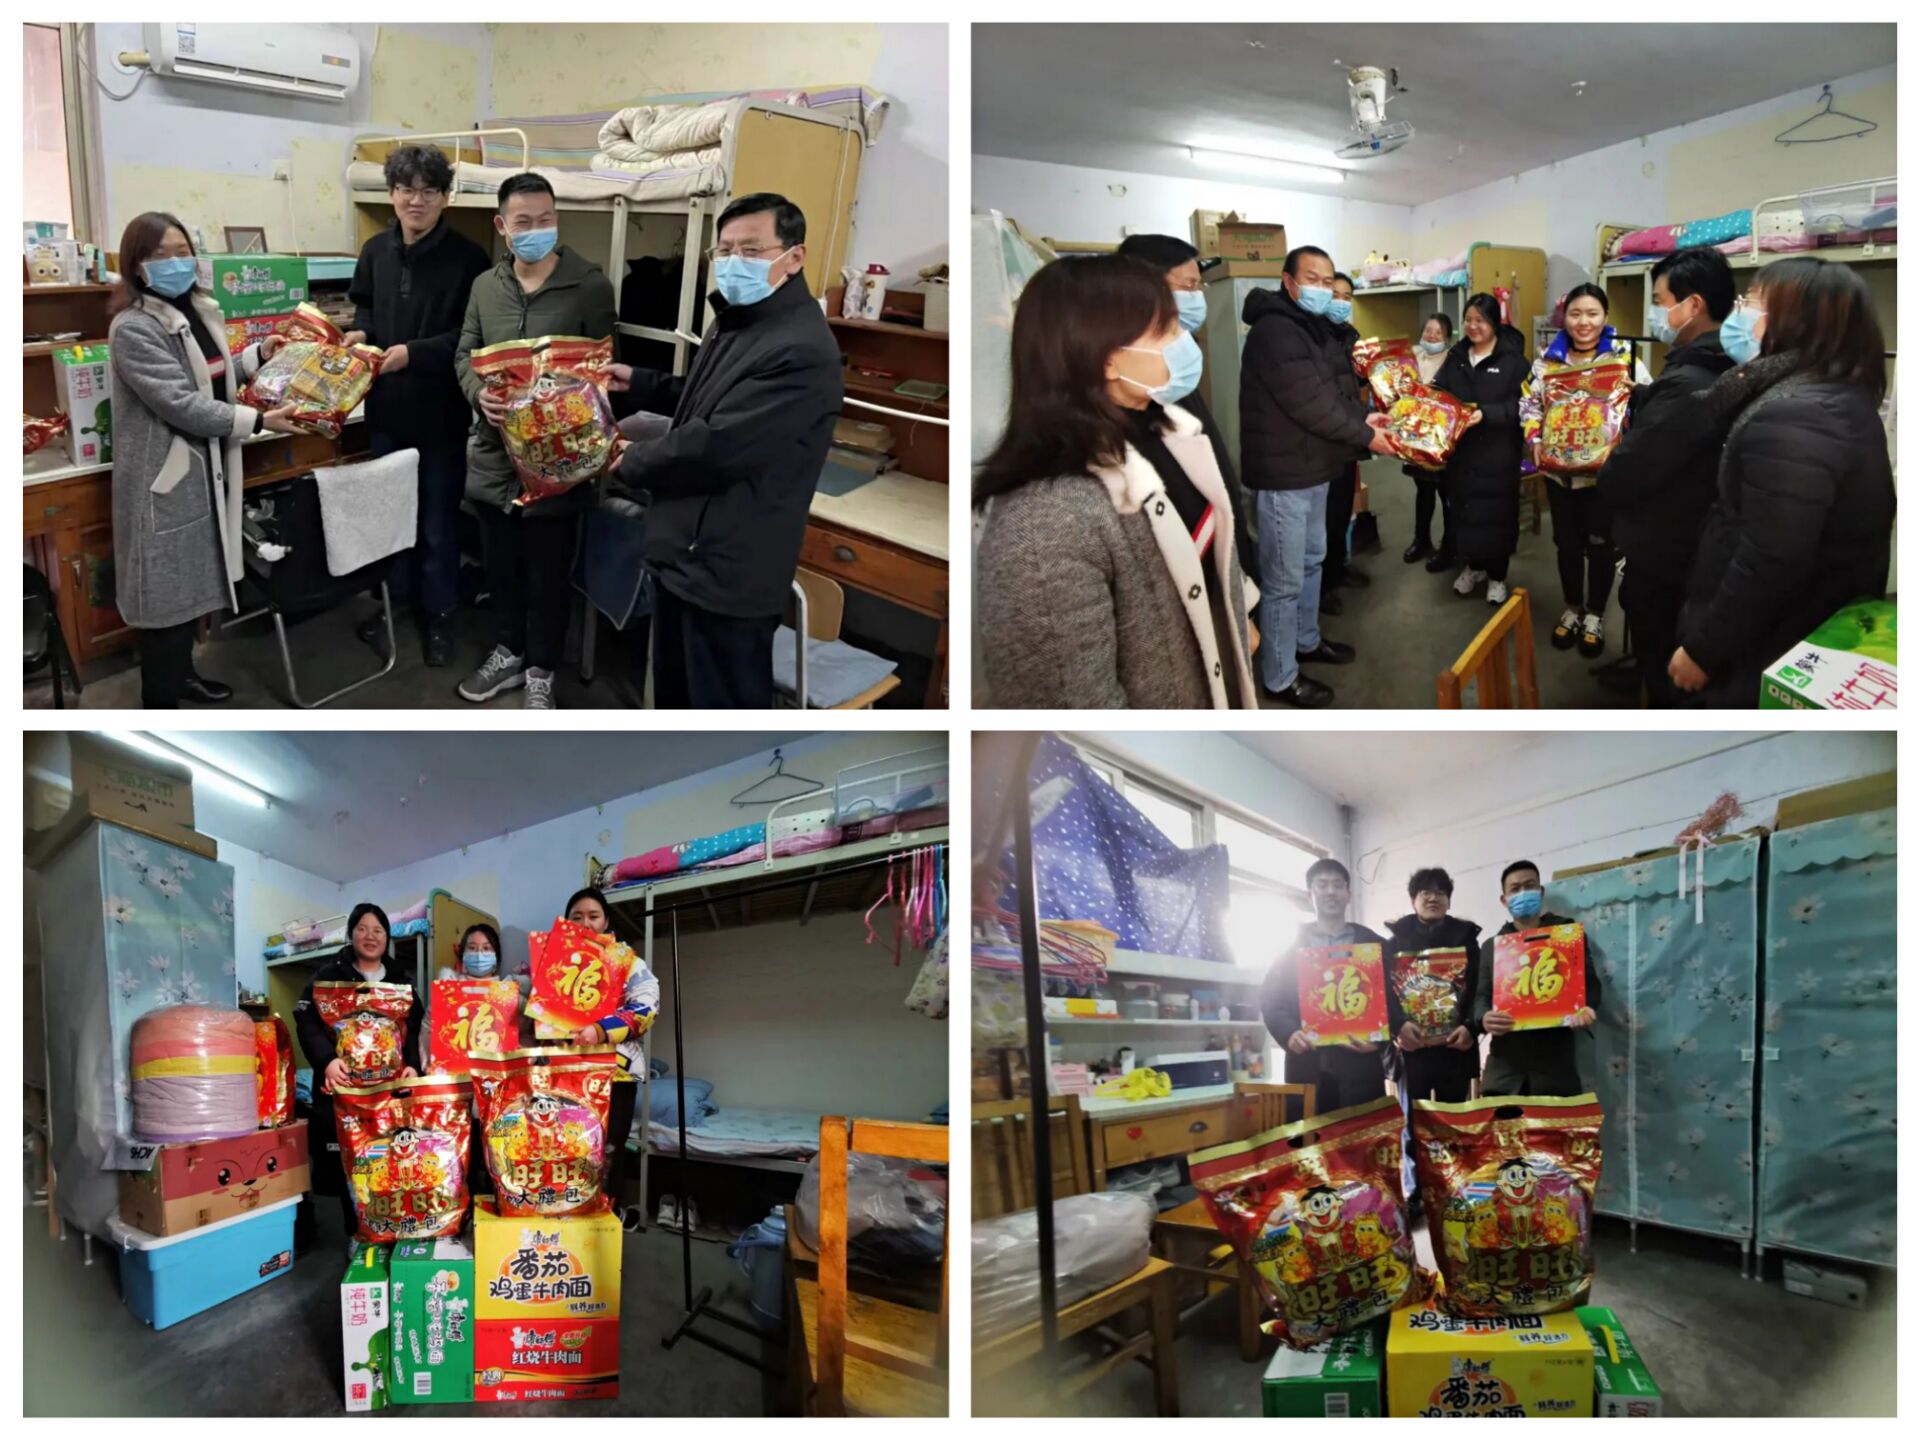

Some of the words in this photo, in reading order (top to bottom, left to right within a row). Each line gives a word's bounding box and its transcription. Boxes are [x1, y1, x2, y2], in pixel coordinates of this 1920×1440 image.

[557, 953, 602, 1011] 福
[1318, 966, 1368, 1020] 福
[1511, 947, 1564, 1004] 福
[449, 1003, 500, 1053] 福
[510, 1160, 594, 1189] 旺旺
[368, 1188, 452, 1218] 旺旺
[510, 1248, 570, 1281] 番茄
[1475, 1247, 1582, 1286] 旺旺
[489, 1275, 592, 1301] 鸡蛋牛肉面
[1297, 1257, 1405, 1313] 旺旺
[511, 1350, 583, 1366] 红烧牛肉面
[1440, 1376, 1503, 1410] 番茄
